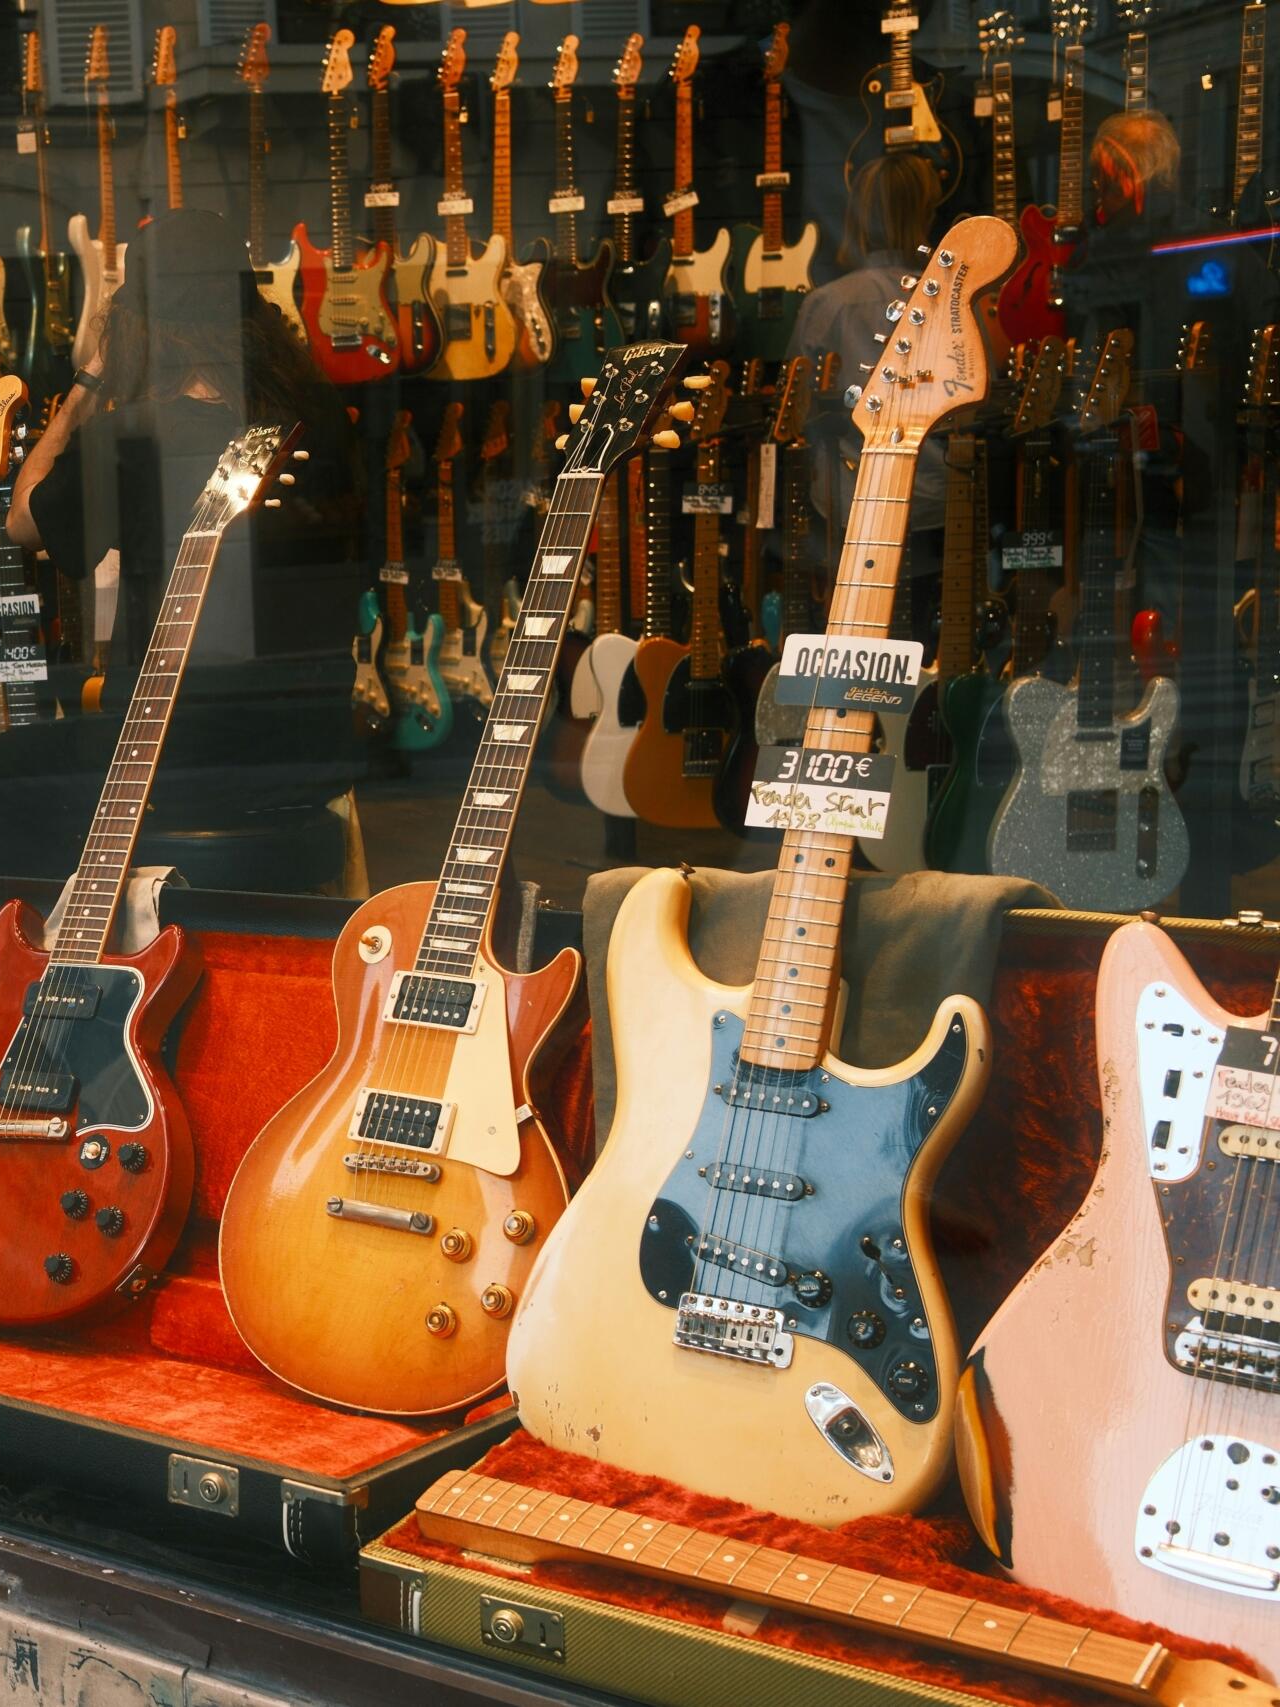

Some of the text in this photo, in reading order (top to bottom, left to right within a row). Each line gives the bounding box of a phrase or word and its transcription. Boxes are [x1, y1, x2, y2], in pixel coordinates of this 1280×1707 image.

[950, 263, 969, 335] STRATOCASTER
[623, 346, 667, 365] Gibson
[943, 341, 974, 397] Fender
[245, 425, 281, 440] Gibson
[795, 647, 912, 684] OCCASION.
[844, 692, 902, 705] LEGEND
[751, 782, 812, 810] Fender
